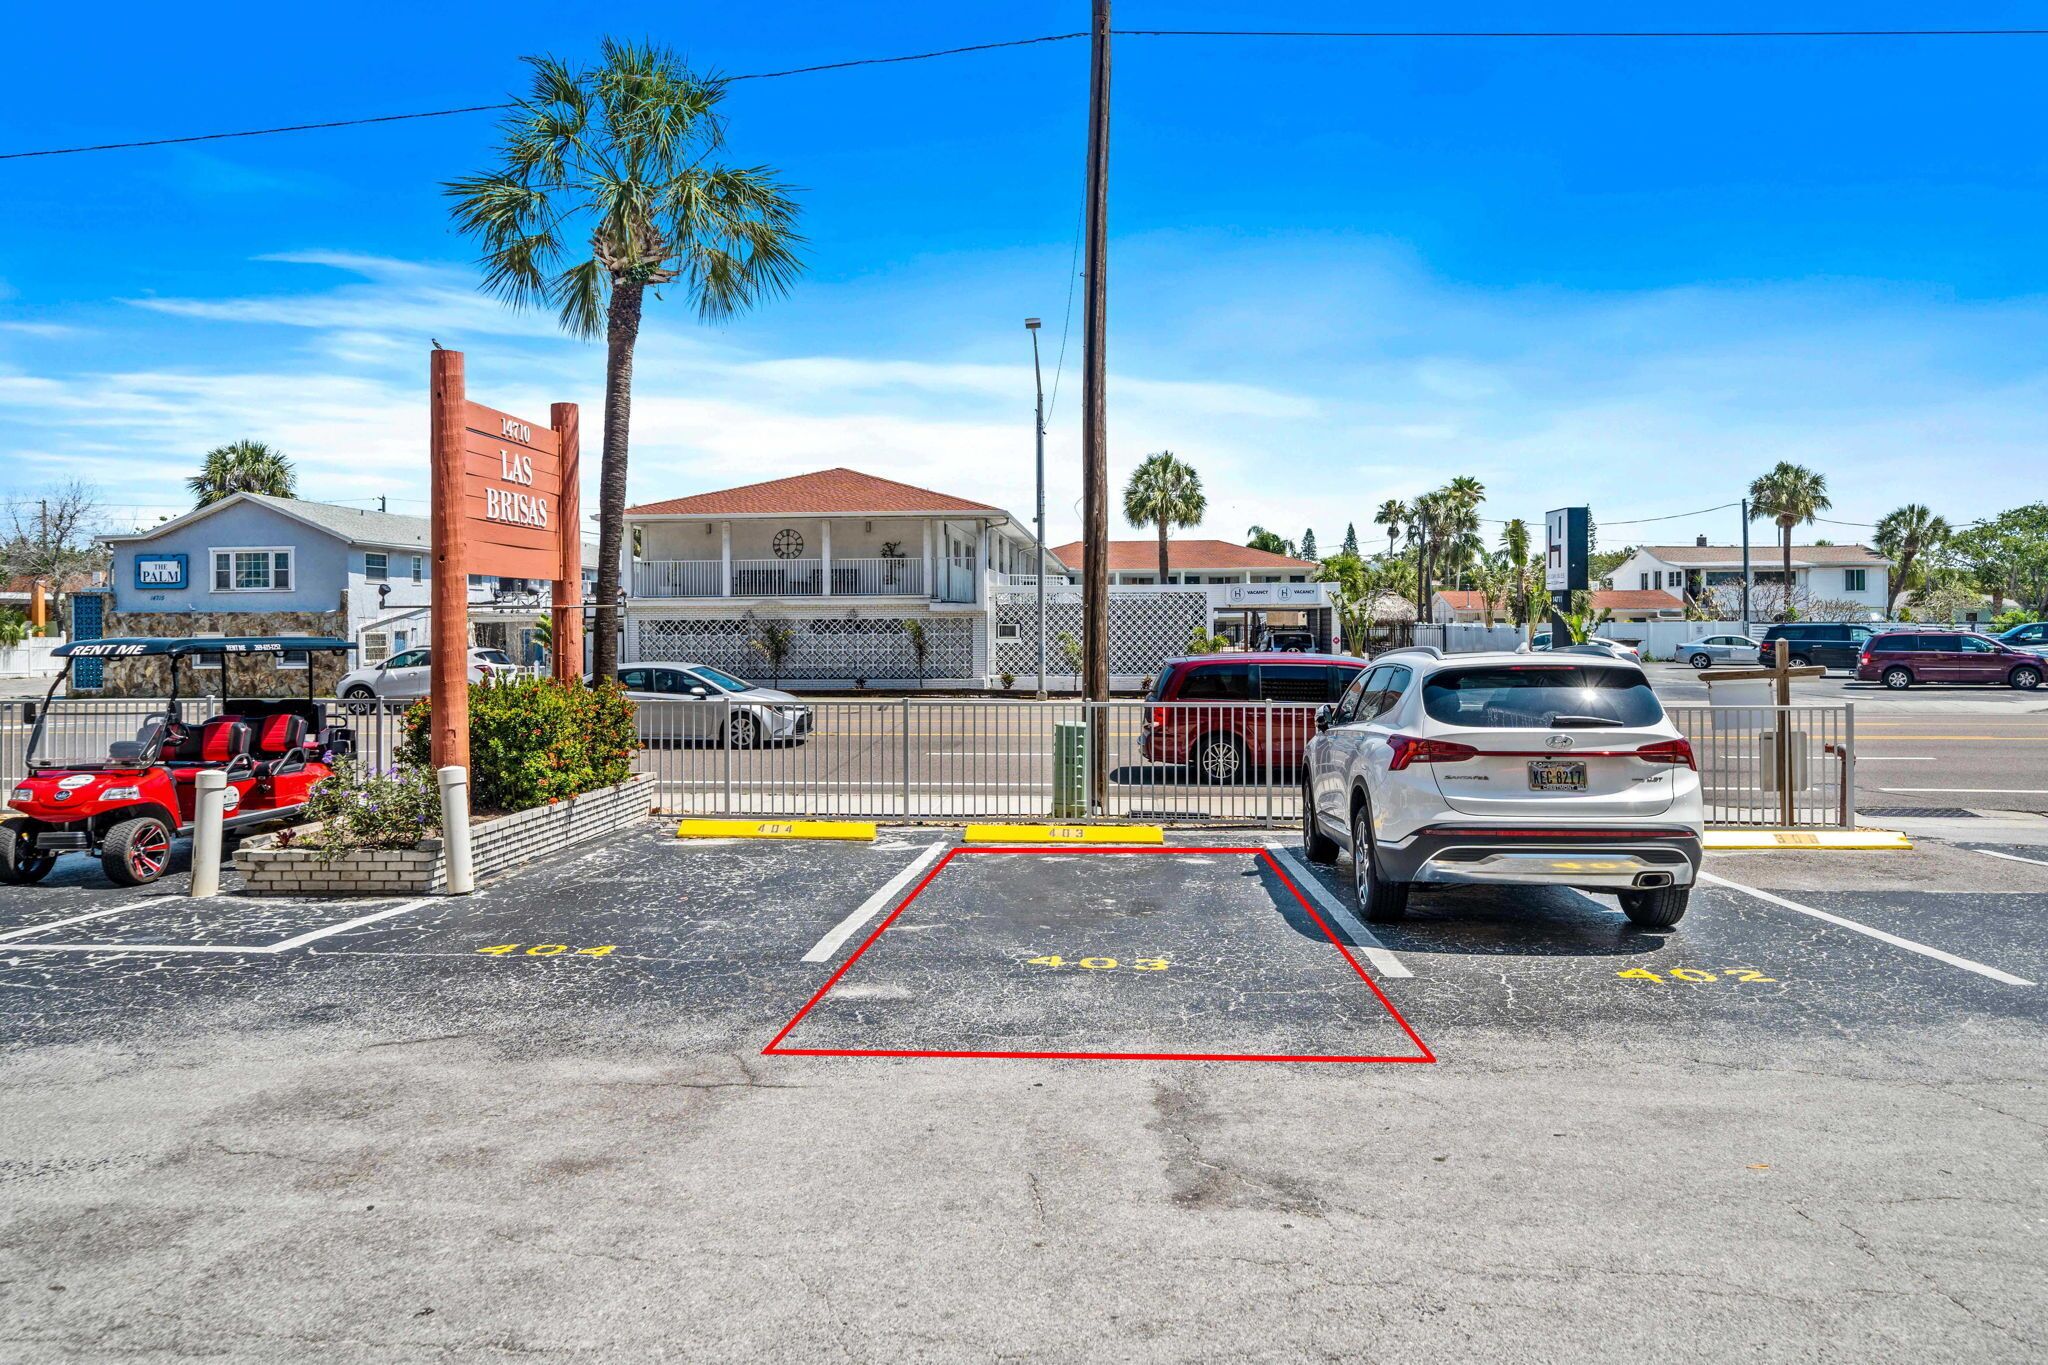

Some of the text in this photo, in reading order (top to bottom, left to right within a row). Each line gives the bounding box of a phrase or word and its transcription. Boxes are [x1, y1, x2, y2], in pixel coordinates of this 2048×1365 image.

[501, 417, 531, 444] 14710
[500, 449, 533, 487] LAS
[485, 487, 548, 529] BRISAS
[154, 563, 168, 571] THE
[143, 571, 179, 582] PALM
[69, 644, 148, 656] RENT ME
[225, 644, 239, 652] RENT
[239, 644, 247, 652] ME
[1533, 770, 1582, 785] KEC 8217
[758, 824, 792, 833] 404
[1049, 828, 1084, 838] 403
[476, 943, 617, 957] 404
[1027, 955, 1170, 971] 403
[1616, 967, 1777, 984] 402
